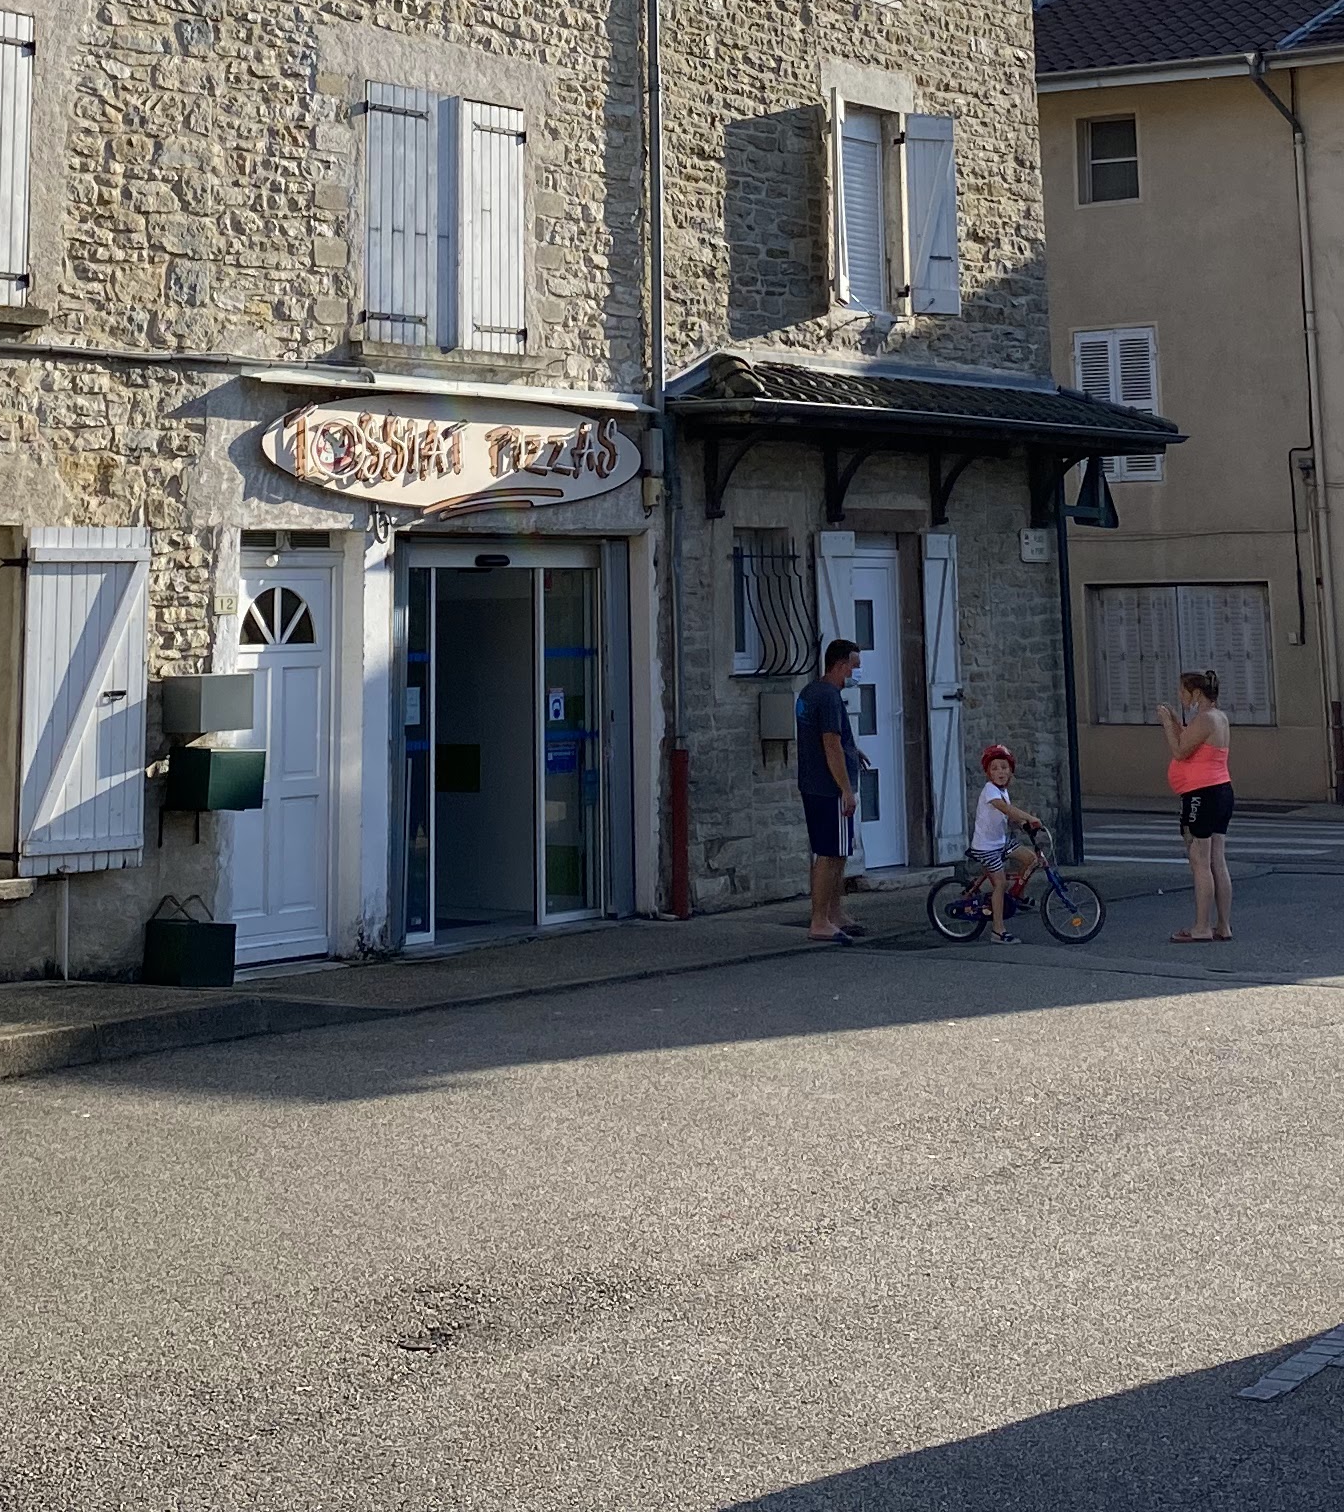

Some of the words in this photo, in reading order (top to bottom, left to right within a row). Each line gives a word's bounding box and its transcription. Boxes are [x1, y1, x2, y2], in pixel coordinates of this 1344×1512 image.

[283, 400, 472, 483] TOSSIAT
[484, 417, 618, 479] PIZZAS
[221, 598, 233, 610] 12
